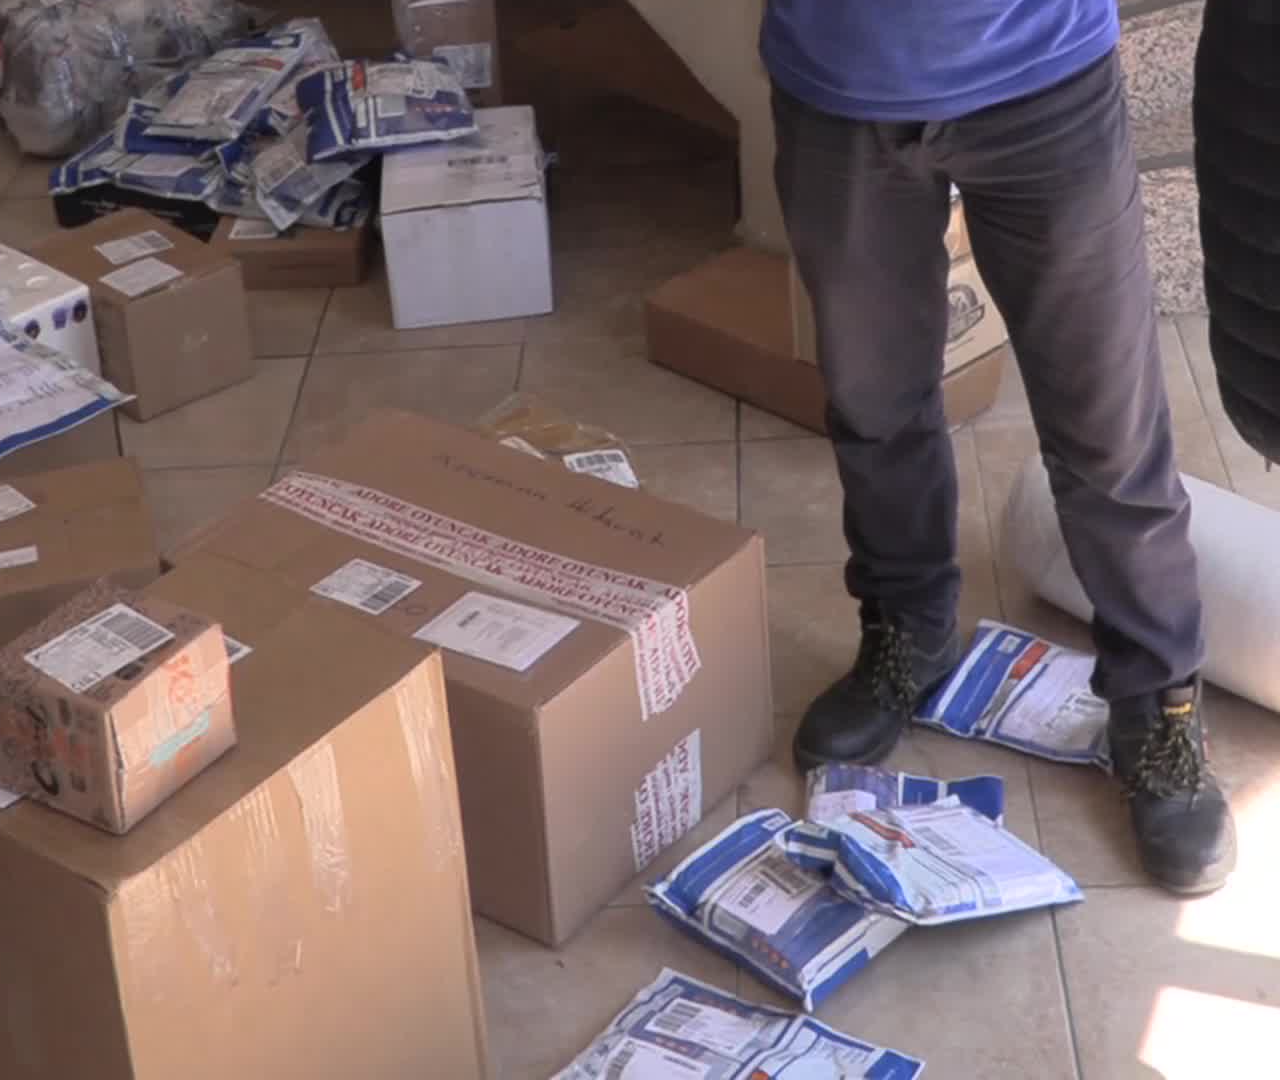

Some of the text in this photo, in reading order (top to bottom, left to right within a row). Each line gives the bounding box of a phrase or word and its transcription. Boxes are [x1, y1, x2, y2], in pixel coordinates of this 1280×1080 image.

[354, 488, 407, 513] ADORE
[411, 509, 489, 546] OYUNCAK
[495, 540, 561, 569] ADORE
[562, 561, 648, 591] OYUNCAK
